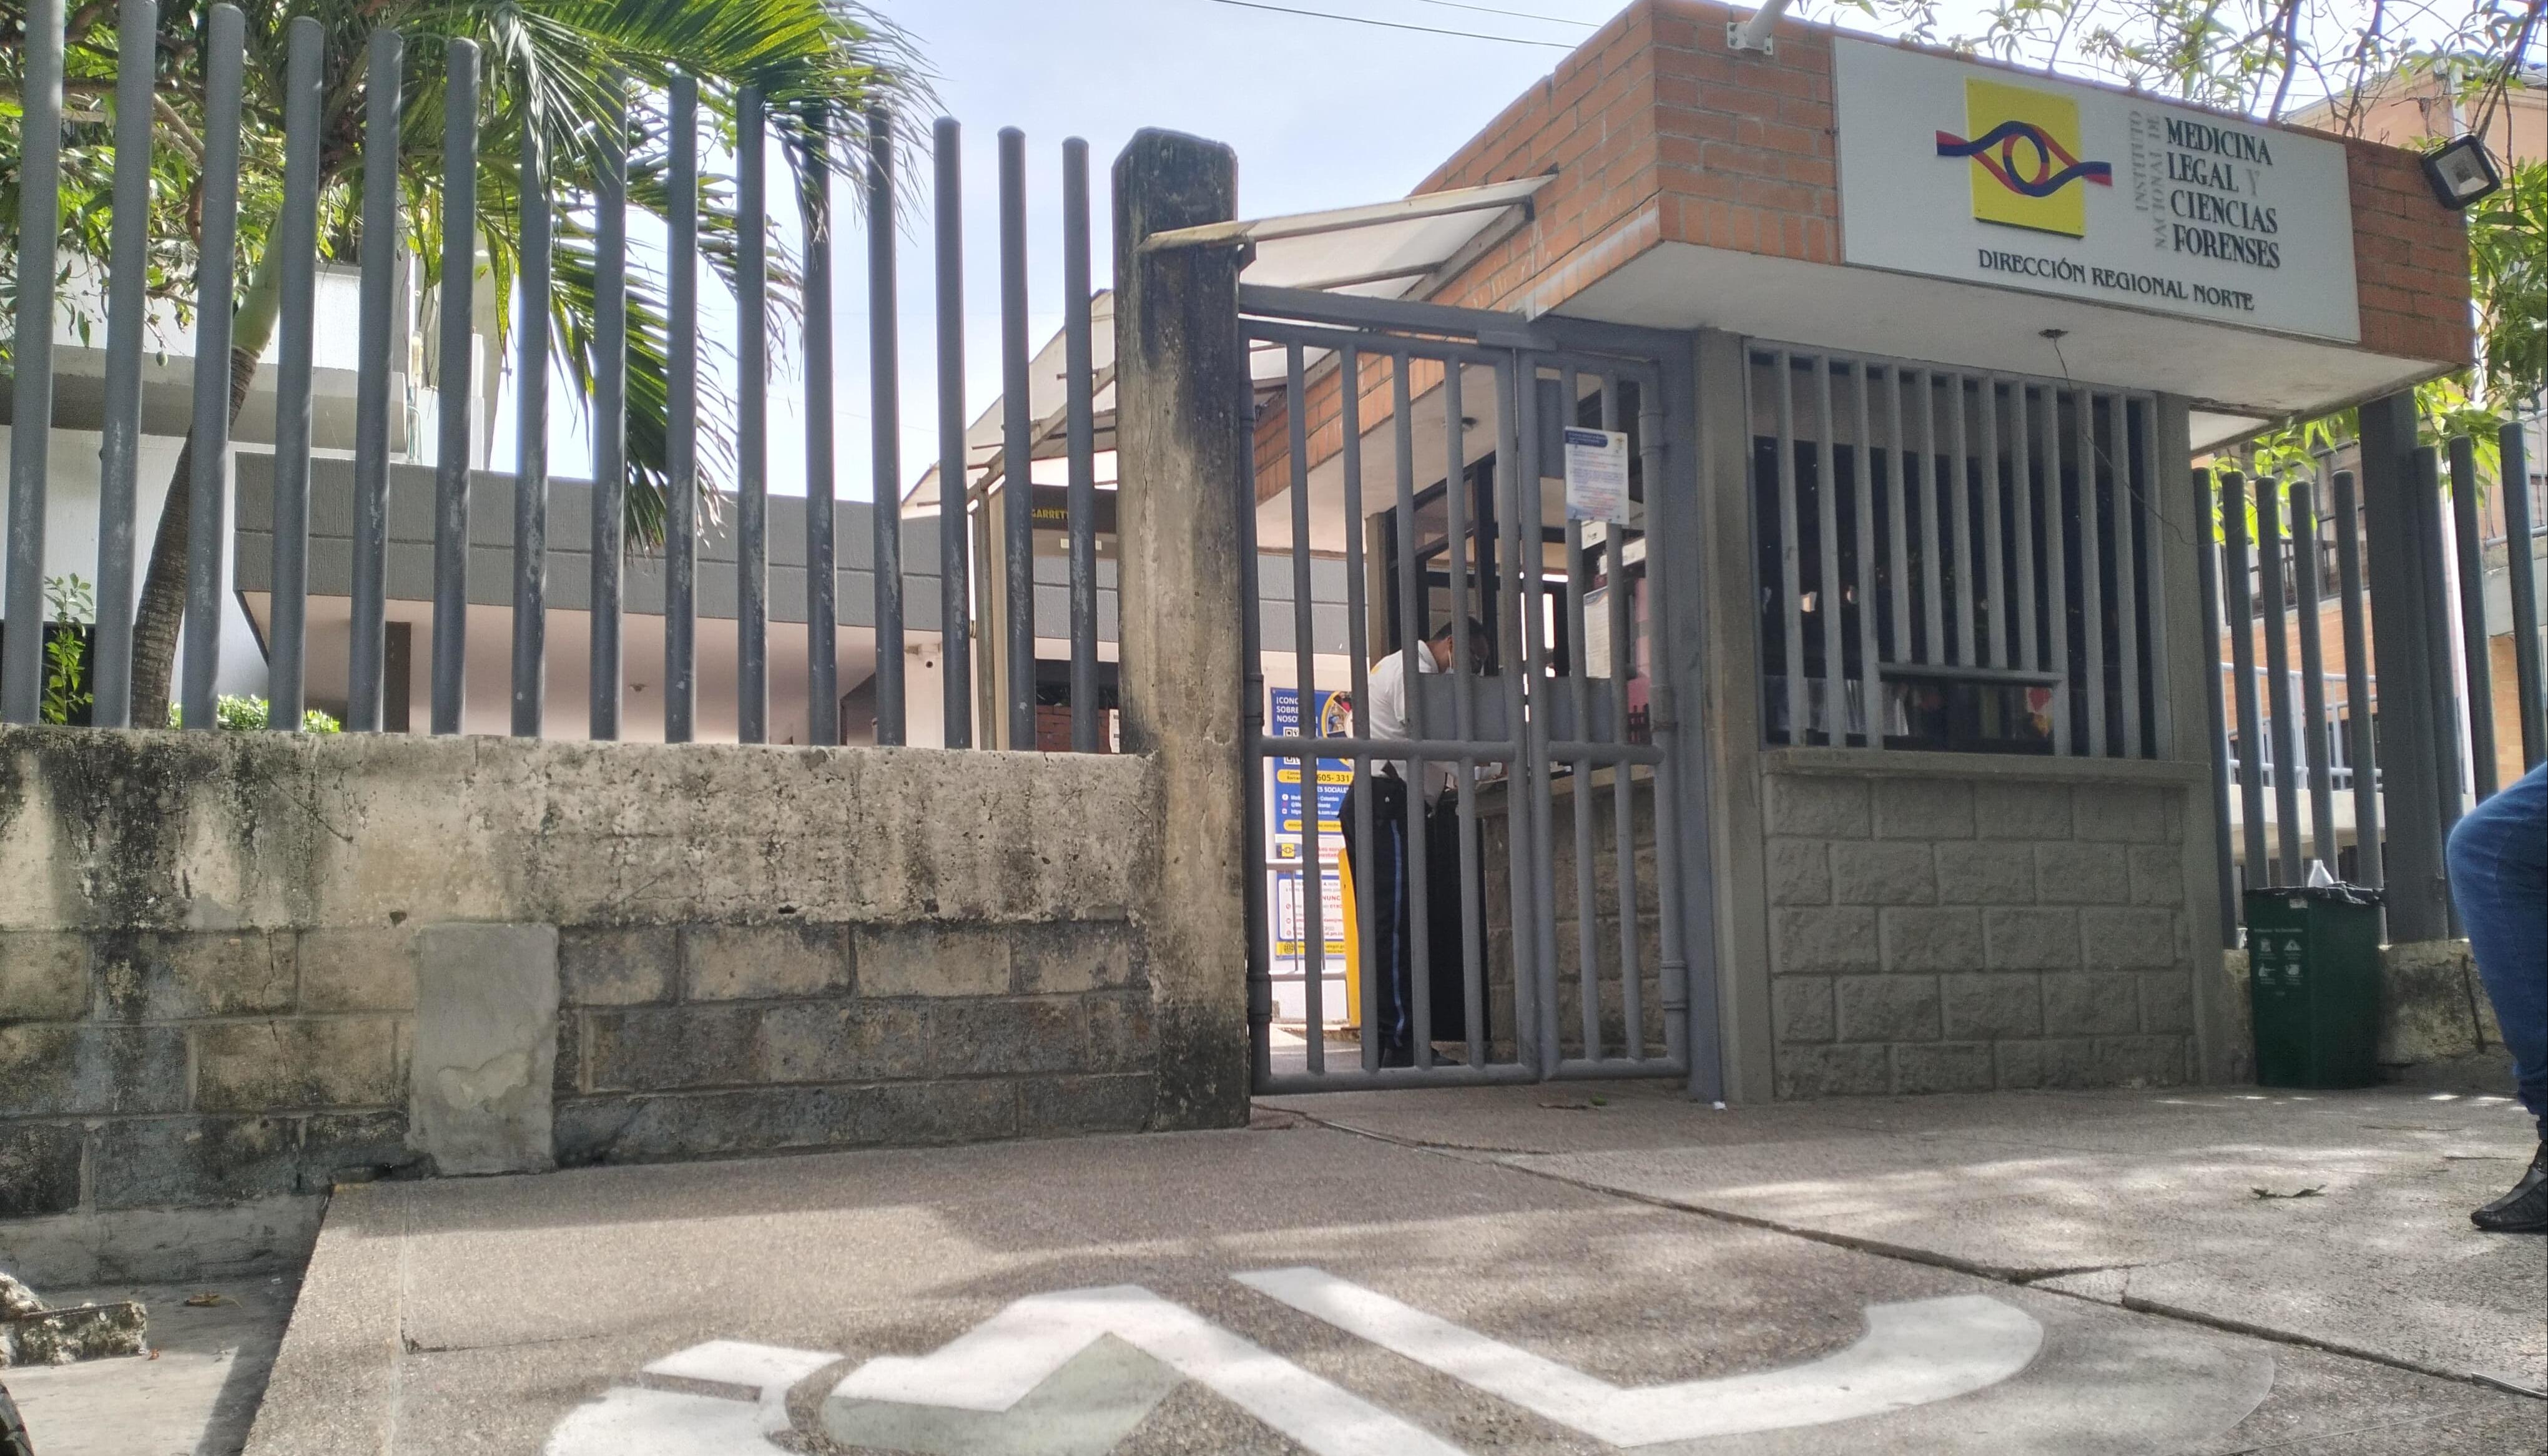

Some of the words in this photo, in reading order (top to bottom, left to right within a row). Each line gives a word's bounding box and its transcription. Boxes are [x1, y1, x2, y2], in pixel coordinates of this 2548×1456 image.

[2147, 114, 2160, 139] DE
[2165, 116, 2273, 166] MEDICINA
[2128, 111, 2149, 211] INSTITUTO
[2167, 151, 2239, 193] LEGAL
[2246, 169, 2260, 197] Y
[2149, 152, 2168, 250] NACIONAL
[2170, 189, 2278, 234] CIENCIAS
[2173, 223, 2281, 268] FORENSES
[1978, 249, 2087, 283] DIRECCIÓN
[2091, 267, 2188, 299] REGIONAL
[2193, 283, 2255, 311] NORTE
[1276, 706, 1299, 714] SOBRE
